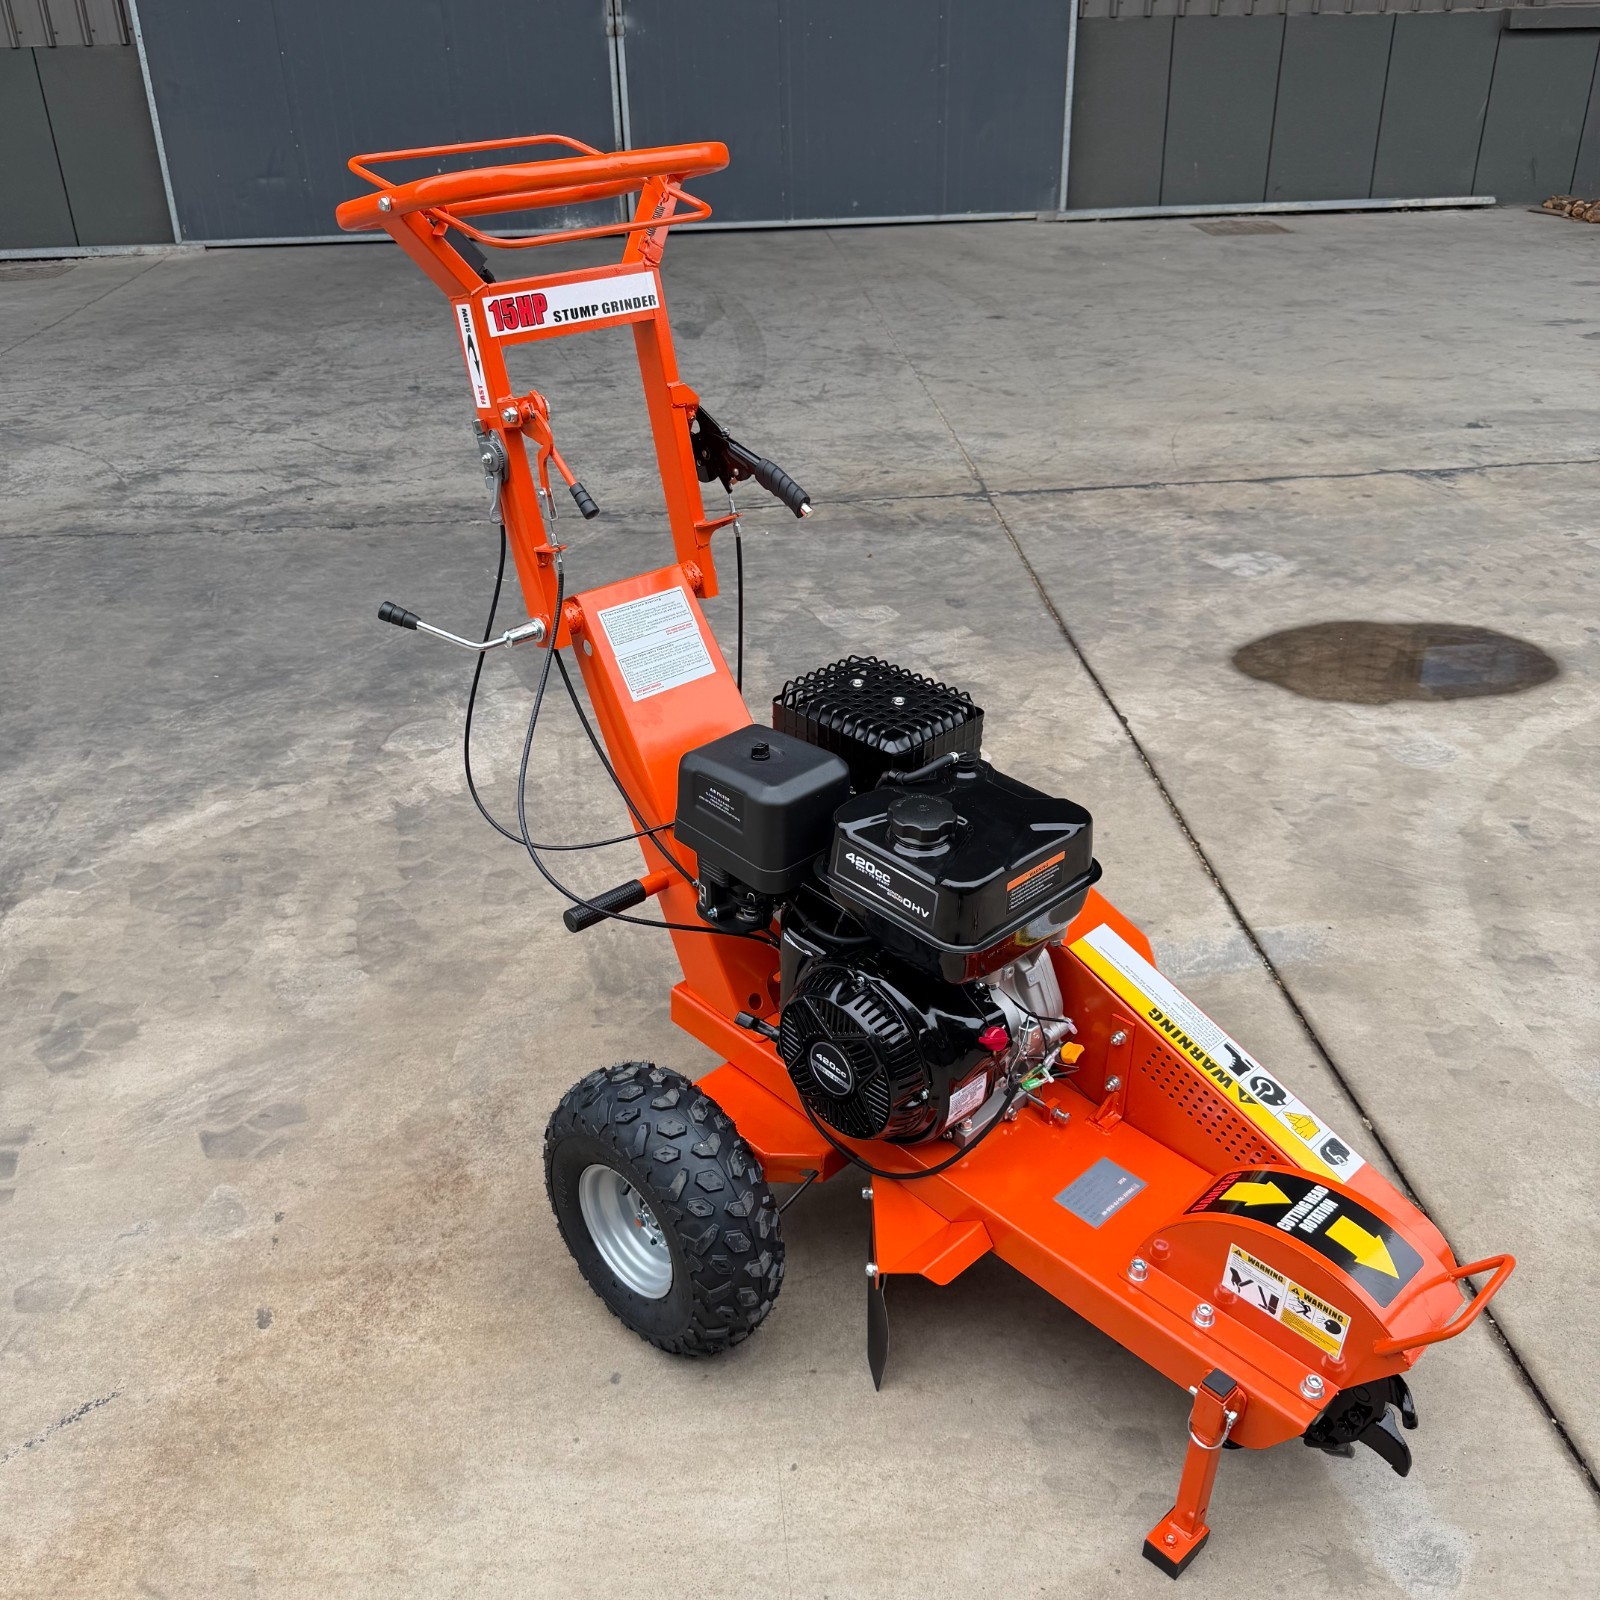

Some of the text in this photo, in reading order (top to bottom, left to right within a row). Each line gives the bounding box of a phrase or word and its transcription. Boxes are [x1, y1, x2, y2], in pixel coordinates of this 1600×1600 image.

[461, 308, 471, 333] SLOW
[488, 293, 657, 332] 15HP STUMP GRINDER
[477, 385, 486, 405] FAST
[845, 852, 890, 883] 420cc
[902, 897, 929, 917] OHV
[1147, 1007, 1233, 1090] WARNING
[816, 1053, 846, 1078] 420cc
[1194, 1171, 1242, 1211] DANGER
[1276, 1184, 1329, 1231] CUTTING HEAD
[1298, 1197, 1338, 1233] ROTATION
[1247, 1255, 1284, 1282] WARNING
[1303, 1292, 1344, 1322] WARNING
